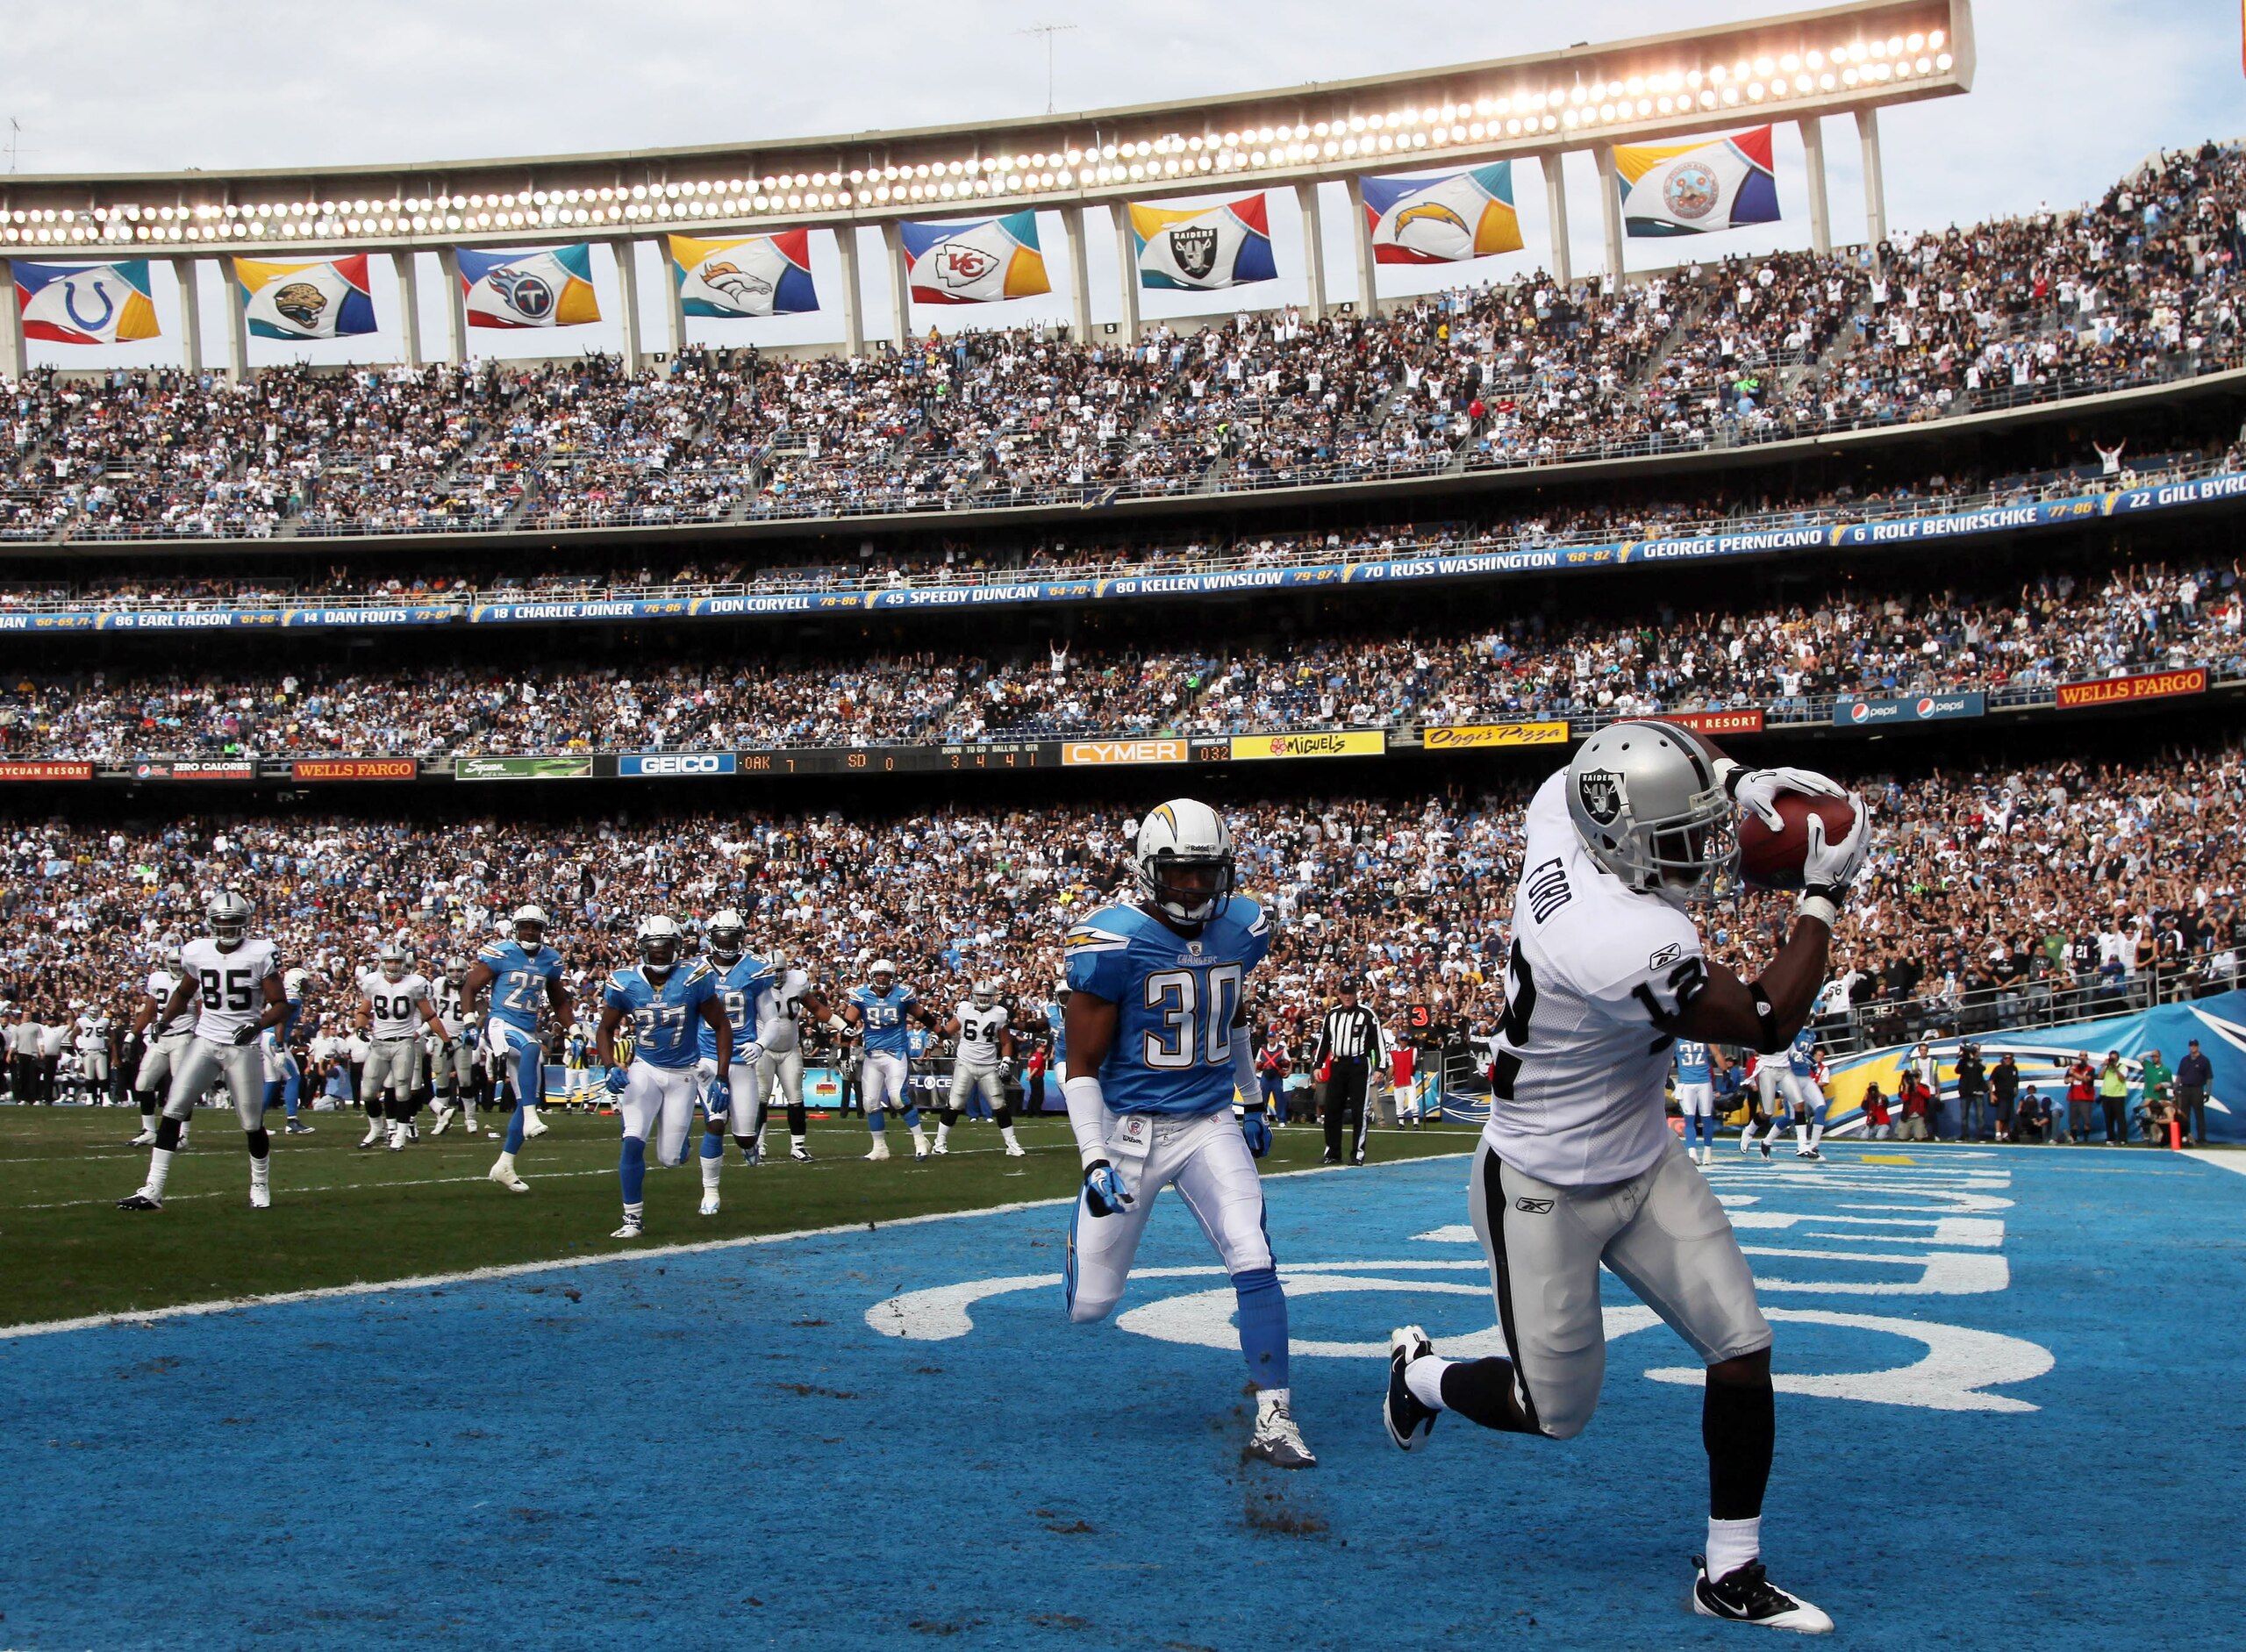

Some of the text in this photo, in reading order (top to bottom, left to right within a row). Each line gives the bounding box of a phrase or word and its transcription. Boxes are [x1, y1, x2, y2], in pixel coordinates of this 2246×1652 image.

[1174, 230, 1213, 240] RAIDERS
[2130, 491, 2150, 508] 22
[2158, 486, 2197, 504] GILL
[1855, 528, 1865, 541] 6
[1873, 521, 1918, 540] ROLF
[1922, 507, 2037, 535] BENIRSCHKE
[1643, 530, 1822, 558] GEORGE PERNICANO
[1364, 566, 1383, 578] 70
[1391, 561, 1434, 577] RUSS
[1439, 552, 1557, 574] WASHINGTON
[1116, 581, 1136, 593] 80
[1141, 576, 1200, 592] KELLEN
[1204, 571, 1284, 589] WINSLOW
[886, 592, 905, 604] 45
[910, 589, 969, 604] SPEEDY
[972, 585, 1040, 602] DUNCAN
[493, 608, 508, 619] 18
[514, 605, 576, 619] CHARLIE
[579, 604, 633, 617] JOINER
[711, 599, 744, 613] DON
[747, 597, 810, 611] CORYELL
[115, 615, 133, 627] 86
[139, 614, 175, 627] EARL
[178, 613, 232, 626] FAISON
[304, 612, 318, 624] 14
[325, 611, 358, 624] DAN
[361, 610, 406, 623] FOUTS
[2062, 672, 2202, 704] WELLS FARGO
[1870, 704, 1898, 718] pepsi
[1936, 700, 1964, 713] pepsi
[1706, 716, 1756, 728] RESORT
[1429, 726, 1563, 746] Oggi's Pizza
[992, 745, 1008, 754] BALL
[1072, 742, 1177, 762] CYMER
[202, 762, 252, 771] CALORIES
[298, 763, 411, 776] WELLS FARGO
[464, 761, 506, 776] Sycuan
[640, 755, 719, 774] GEICO
[745, 756, 794, 772] OAK 7
[848, 754, 894, 770] SD 0
[951, 753, 1034, 769] 3 4 4 1
[1526, 856, 1572, 925] FORD
[1177, 954, 1217, 964] CHARGERS
[2076, 945, 2088, 958] 21
[200, 969, 252, 1011] 85
[502, 970, 547, 1012] 23
[374, 995, 411, 1020] 80
[705, 990, 747, 1030] 9
[1144, 961, 1244, 1070] 30
[1411, 1006, 1429, 1026] 3
[86, 1027, 104, 1038] 75
[633, 1004, 687, 1048] 27
[964, 1019, 996, 1042] 64
[910, 1038, 922, 1050] 56
[1679, 1043, 1706, 1066] 32
